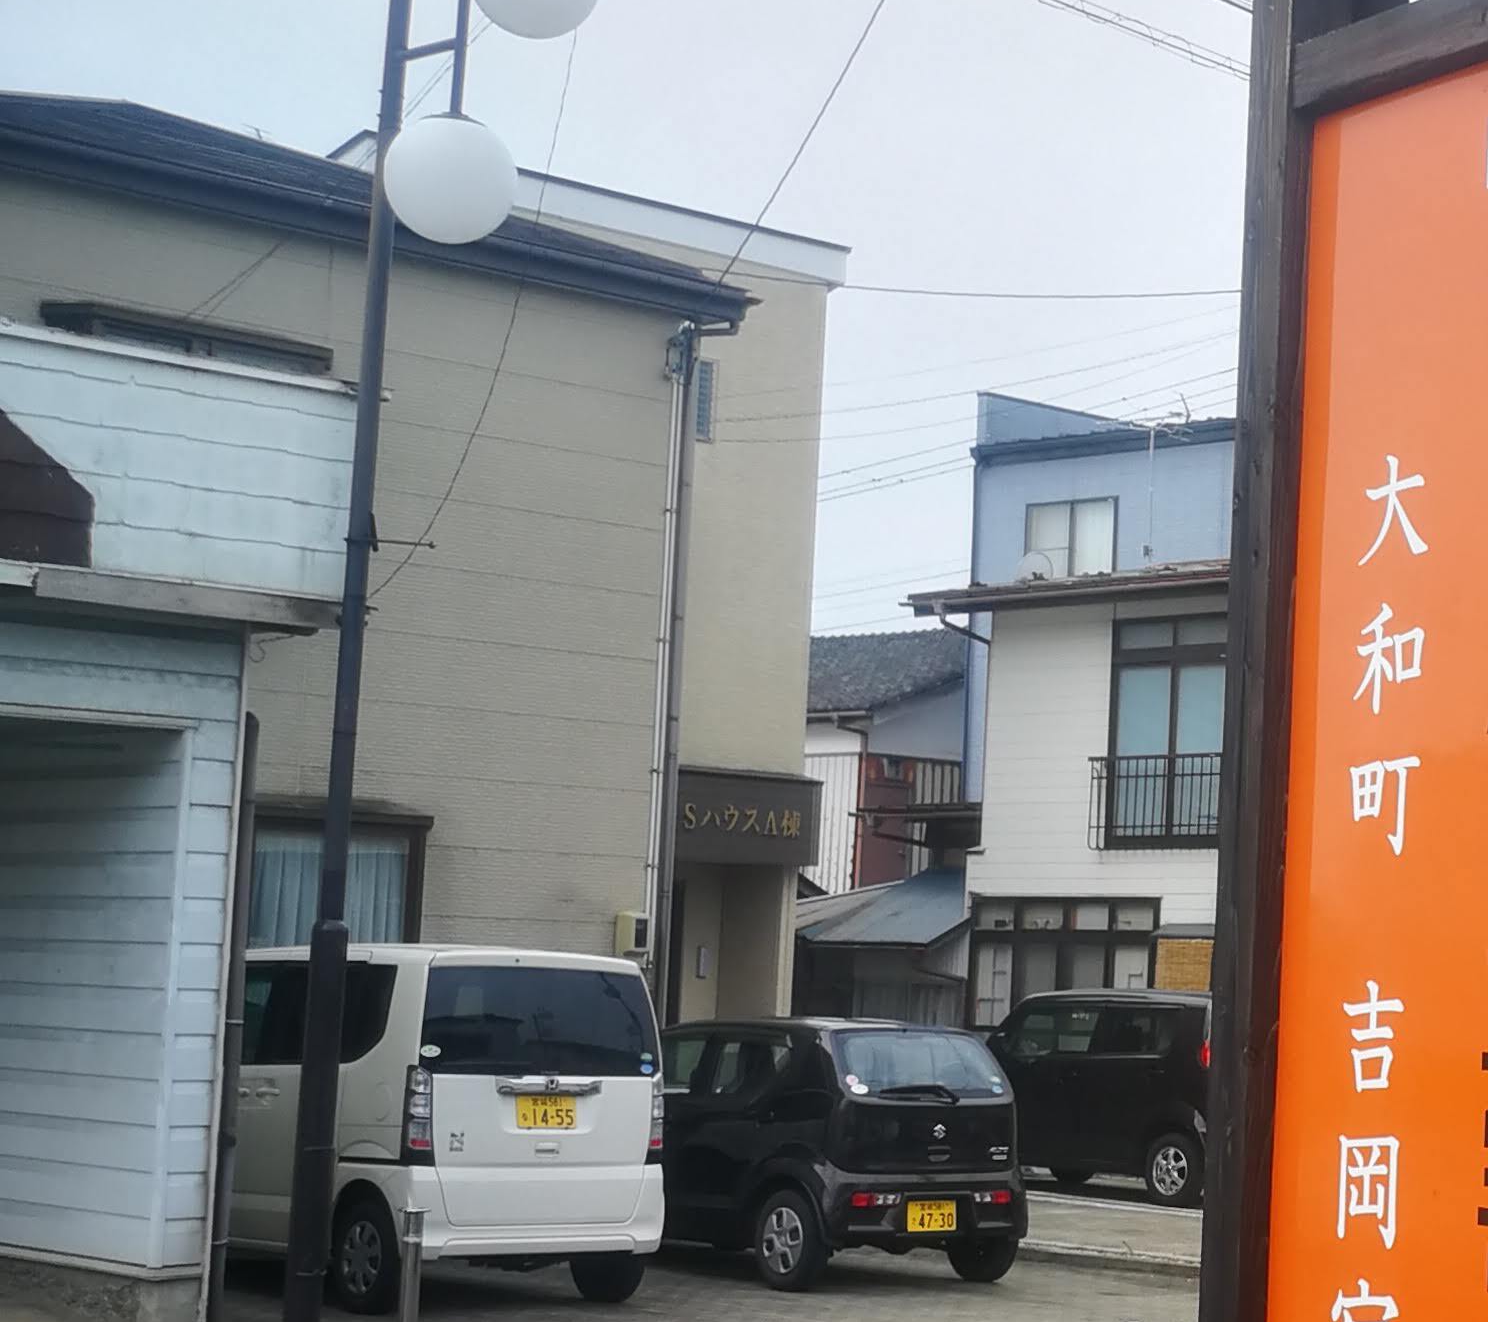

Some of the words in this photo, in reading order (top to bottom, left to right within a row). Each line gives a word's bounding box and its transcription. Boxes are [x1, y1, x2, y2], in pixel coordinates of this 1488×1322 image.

[1349, 454, 1429, 857] 大和町
[532, 1108, 574, 1126] 14-55
